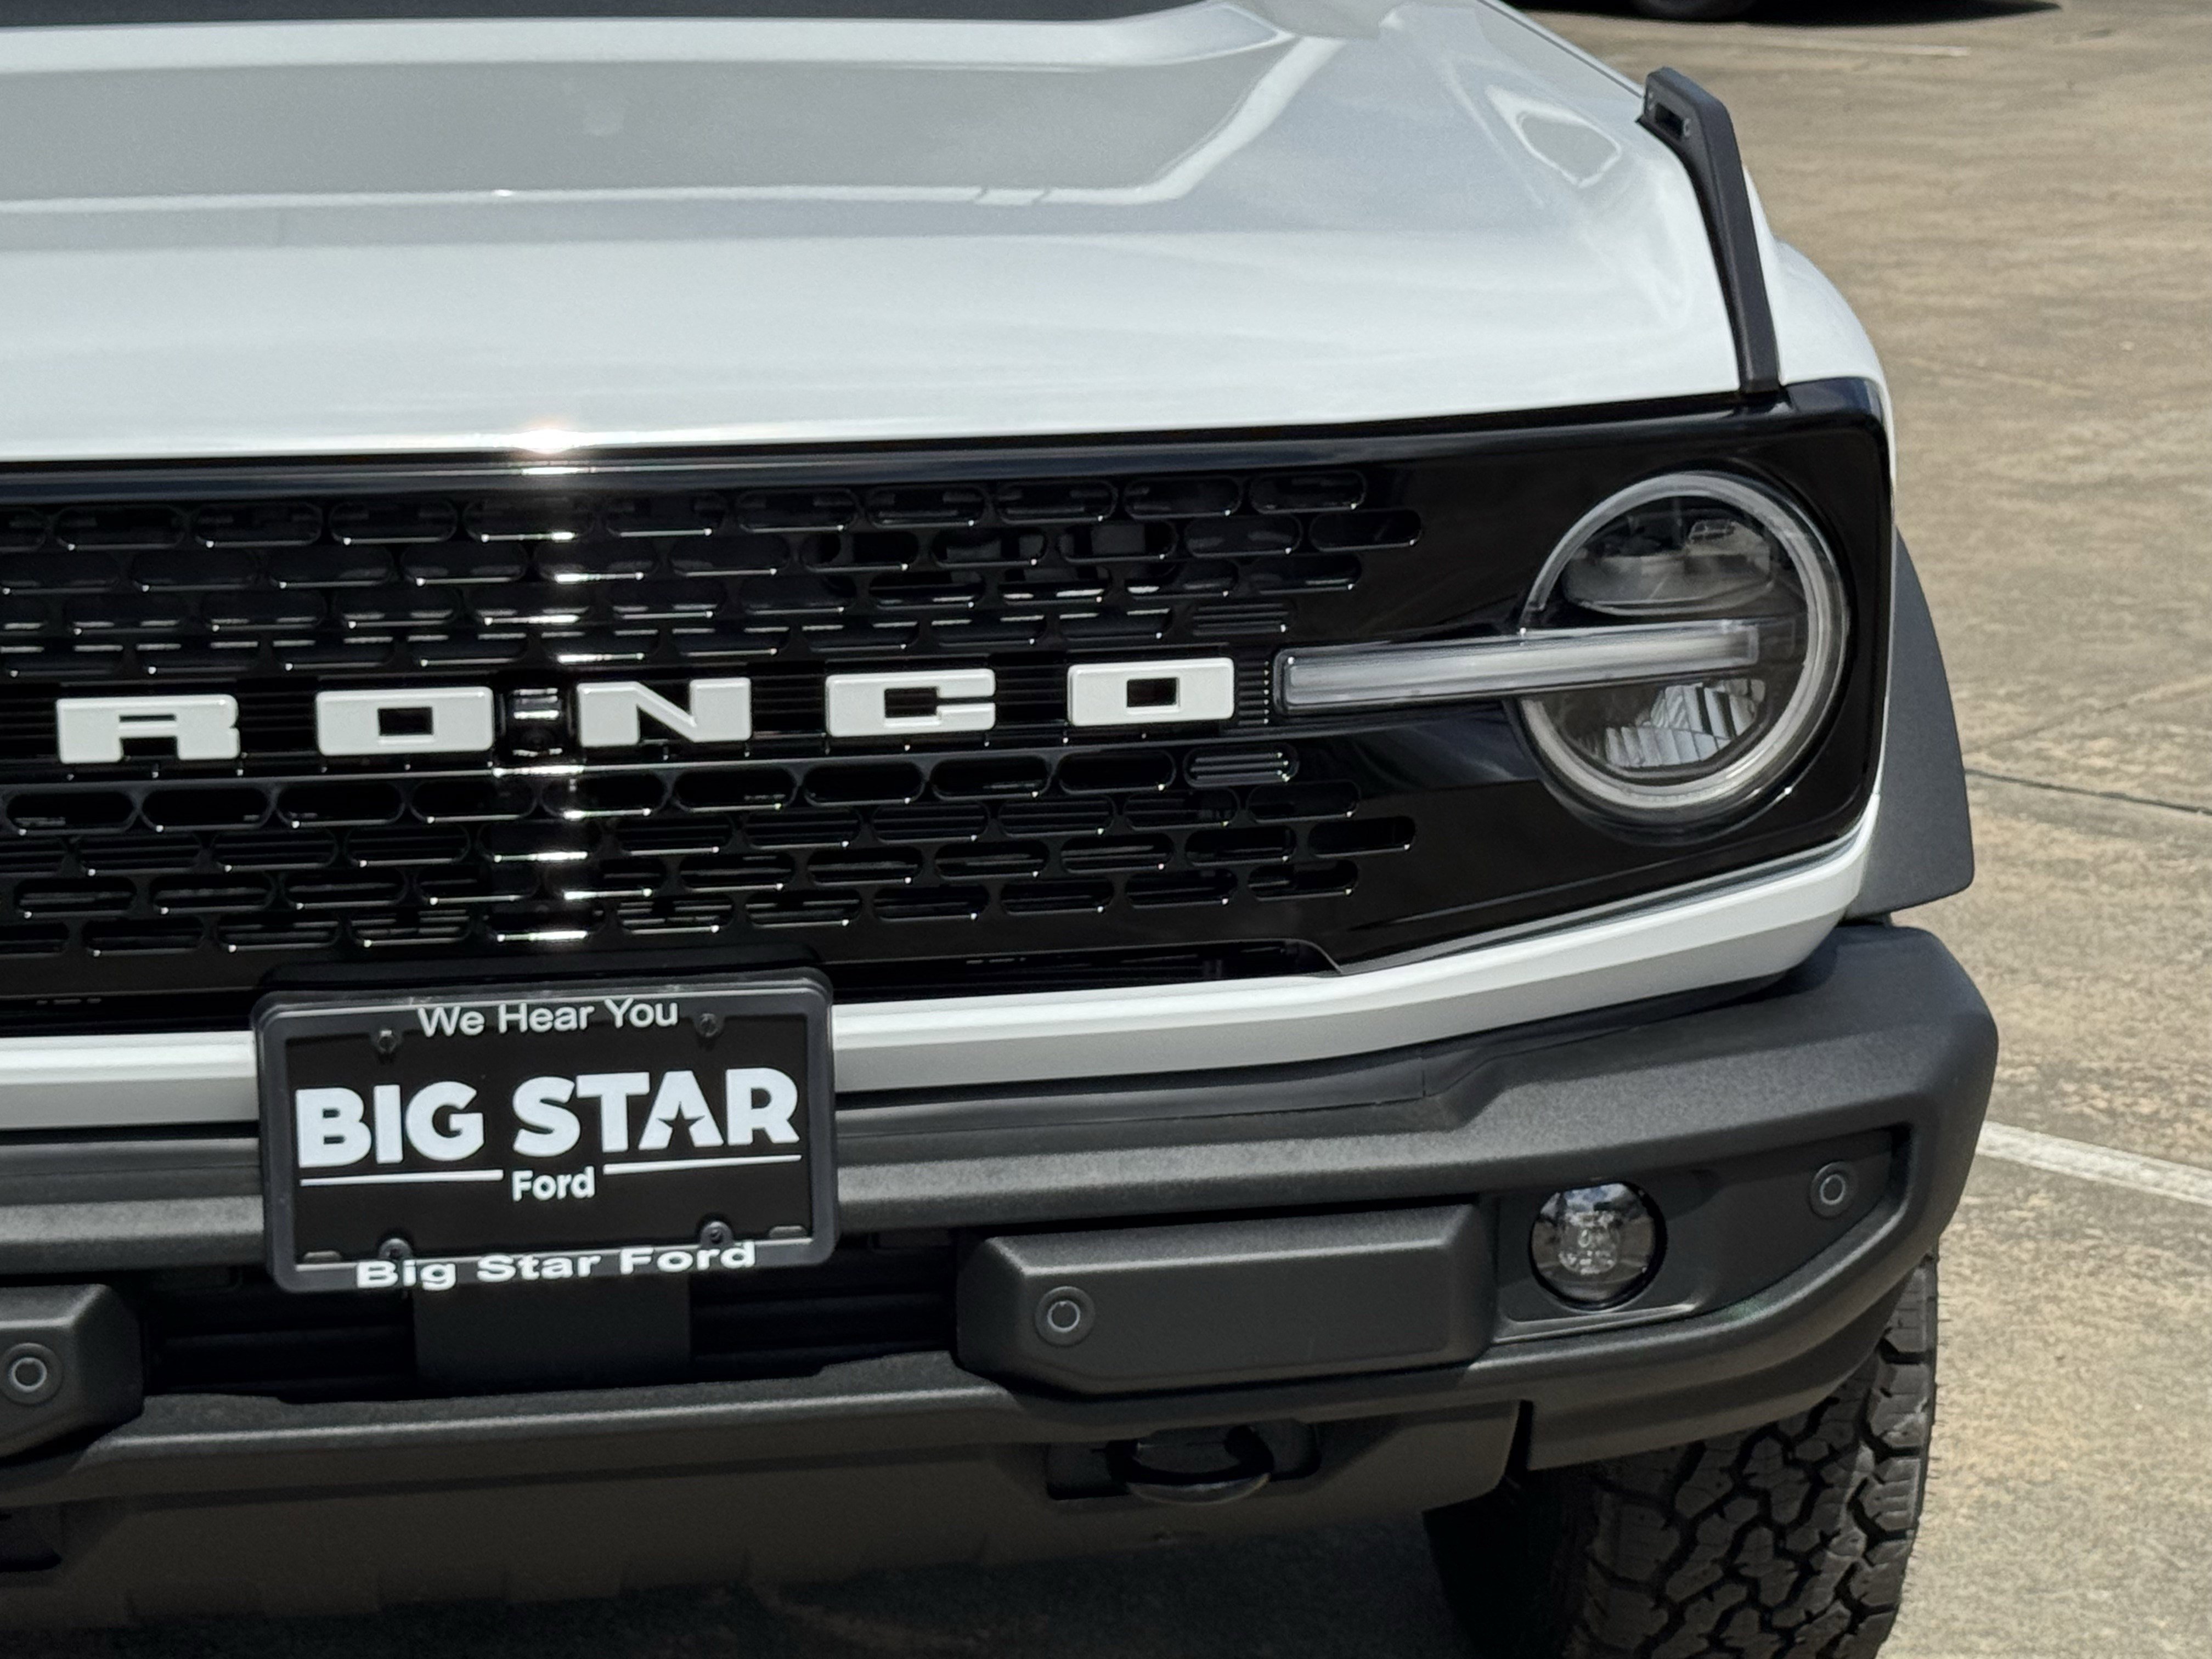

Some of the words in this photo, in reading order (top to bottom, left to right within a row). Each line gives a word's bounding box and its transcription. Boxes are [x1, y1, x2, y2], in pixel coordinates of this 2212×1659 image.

[56, 657, 1234, 763] RONCO
[417, 1006, 486, 1037] We
[498, 1002, 595, 1034] Hear
[604, 997, 679, 1029] You
[295, 1081, 484, 1168] BIG
[512, 1067, 800, 1157] STAR
[512, 1165, 596, 1201] Ford
[356, 1260, 457, 1291] Big
[477, 1254, 602, 1282] Star
[619, 1240, 756, 1274] Ford
